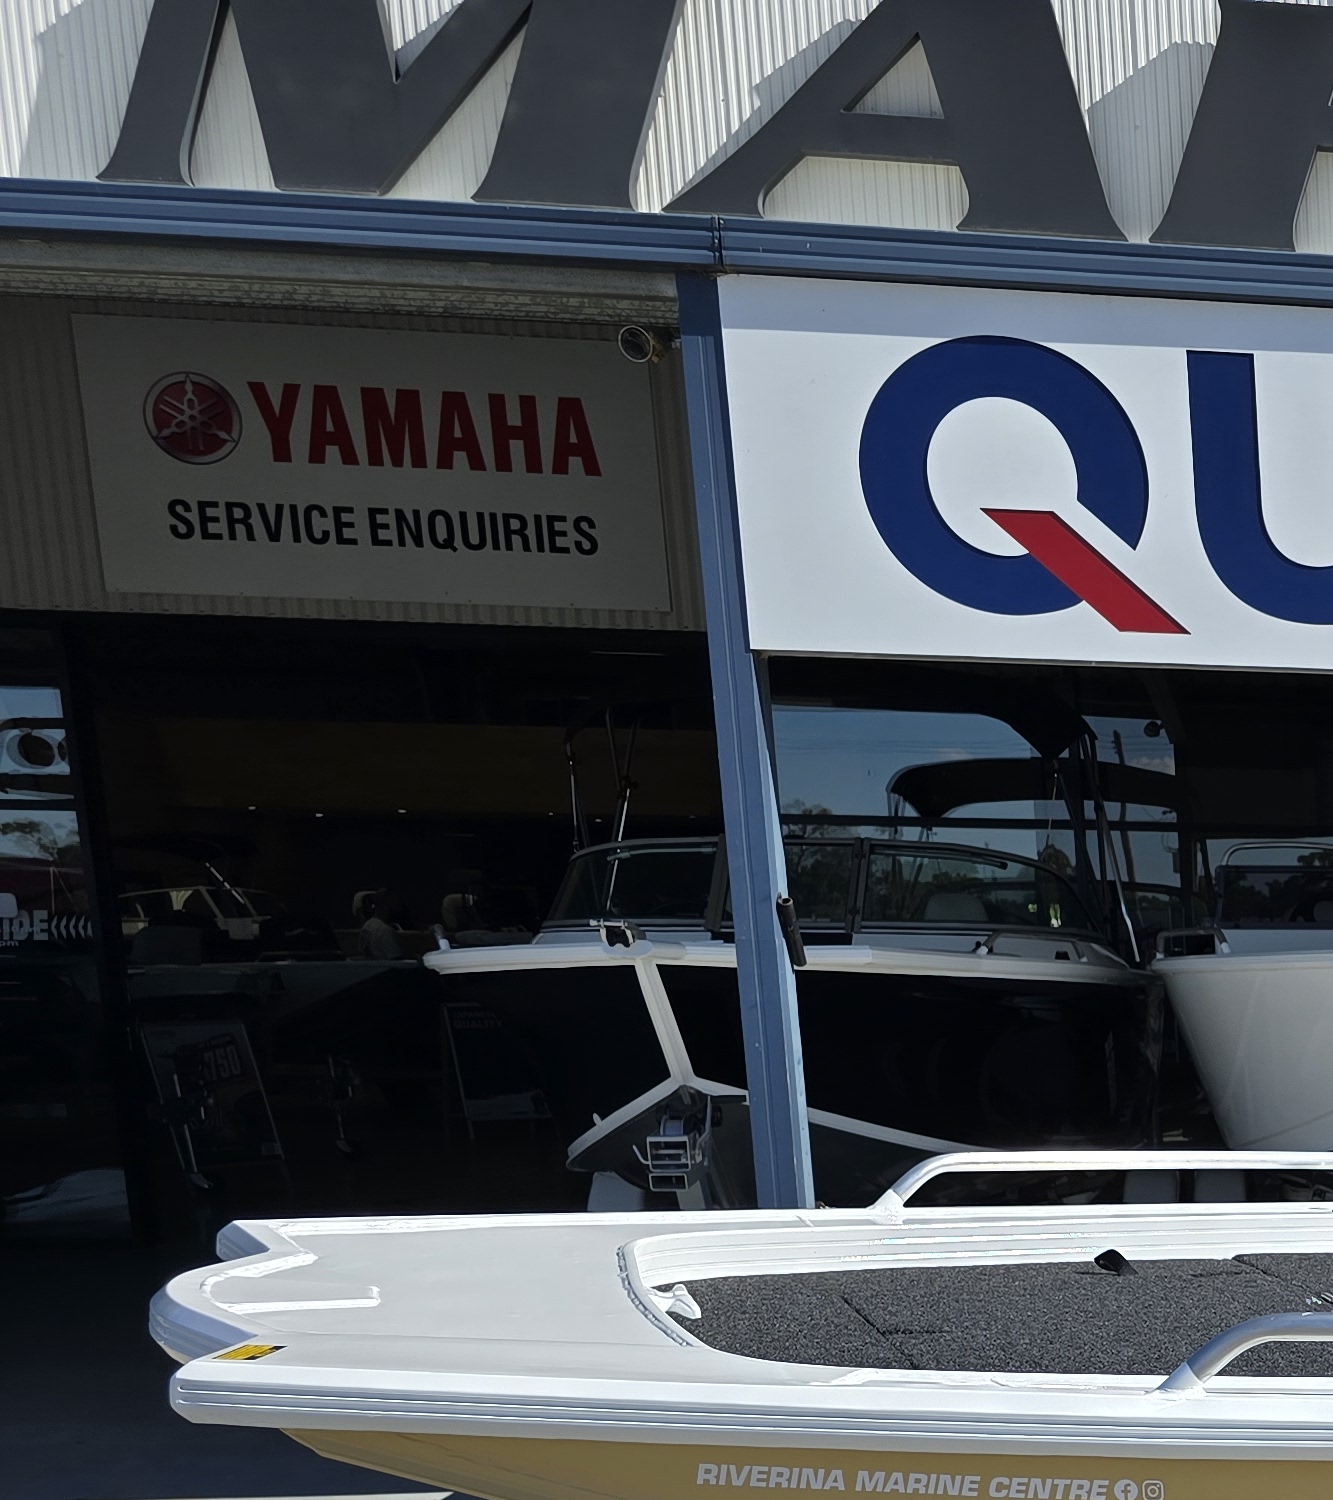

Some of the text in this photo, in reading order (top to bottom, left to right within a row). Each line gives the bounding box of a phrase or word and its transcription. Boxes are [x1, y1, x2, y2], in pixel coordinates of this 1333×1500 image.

[246, 382, 602, 477] YAMAHA
[167, 499, 599, 556] SERVICE ENQUIRIES
[696, 1463, 1109, 1500] RIVERINA MARINE CENTRE
